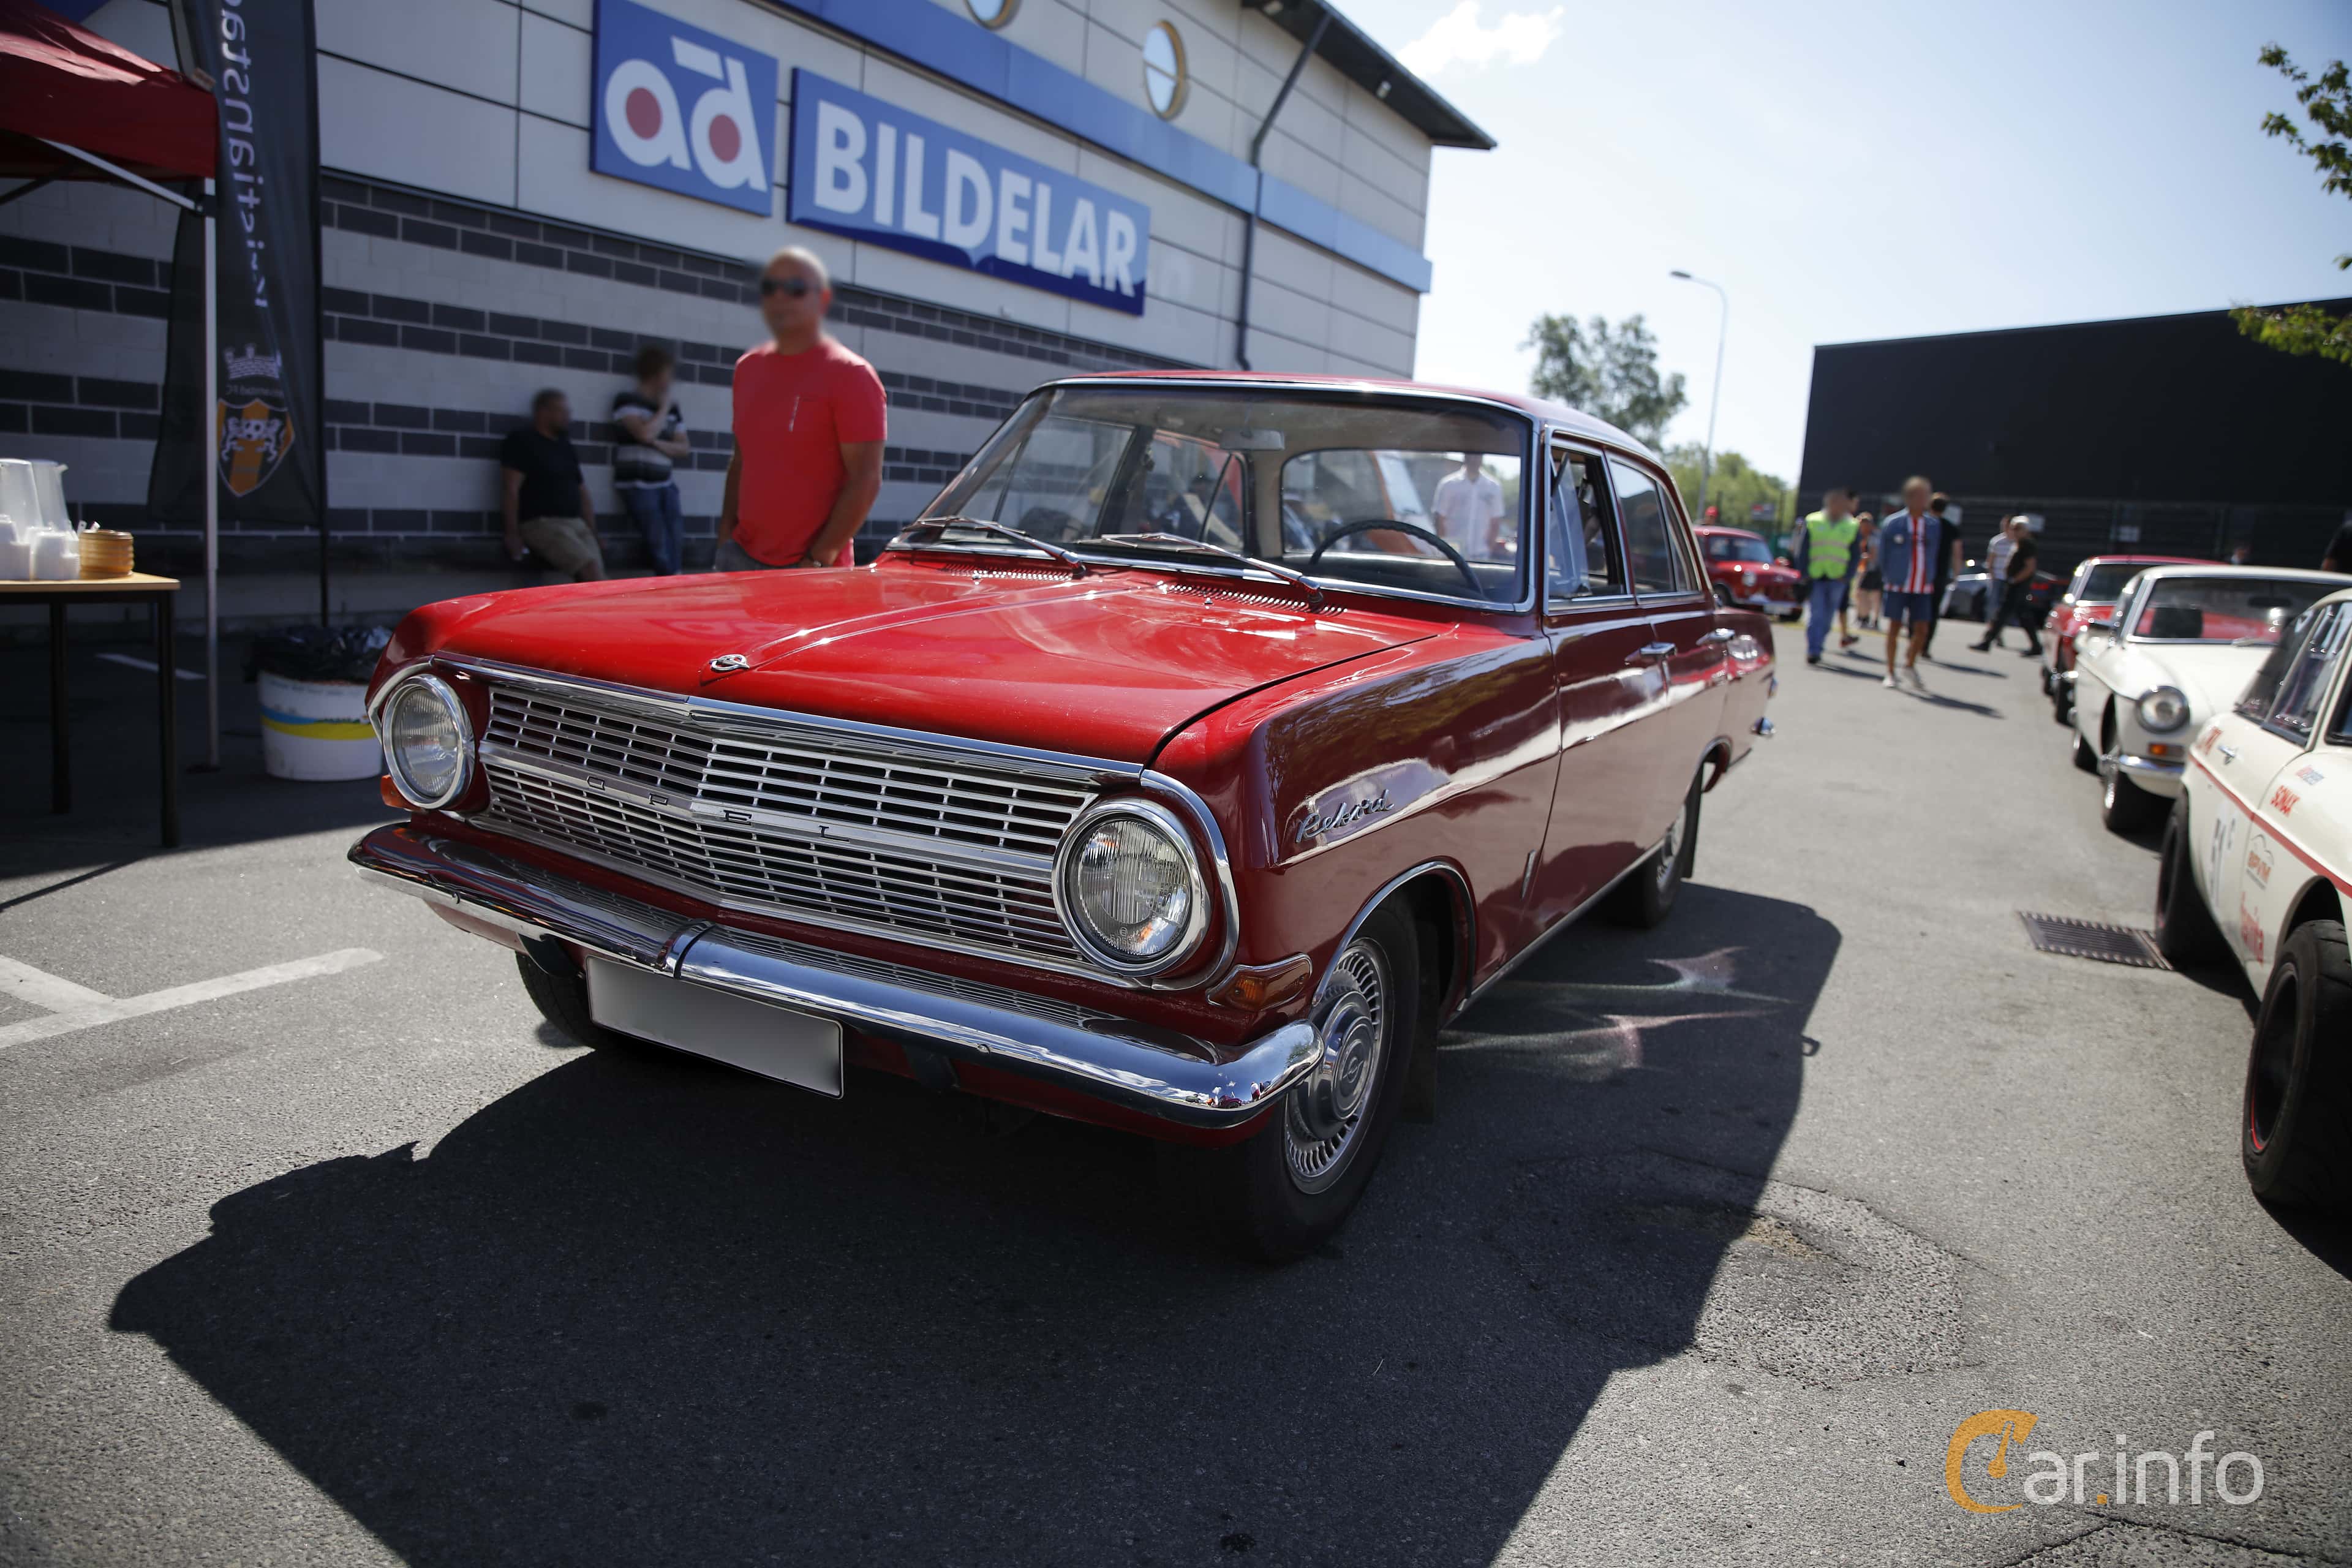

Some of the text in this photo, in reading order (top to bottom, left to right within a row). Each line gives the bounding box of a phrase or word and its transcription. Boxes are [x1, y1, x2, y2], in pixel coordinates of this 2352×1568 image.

[814, 100, 1135, 297] BILDELAR
[587, 776, 850, 842] OPEL
[1295, 789, 1395, 843] Rekord
